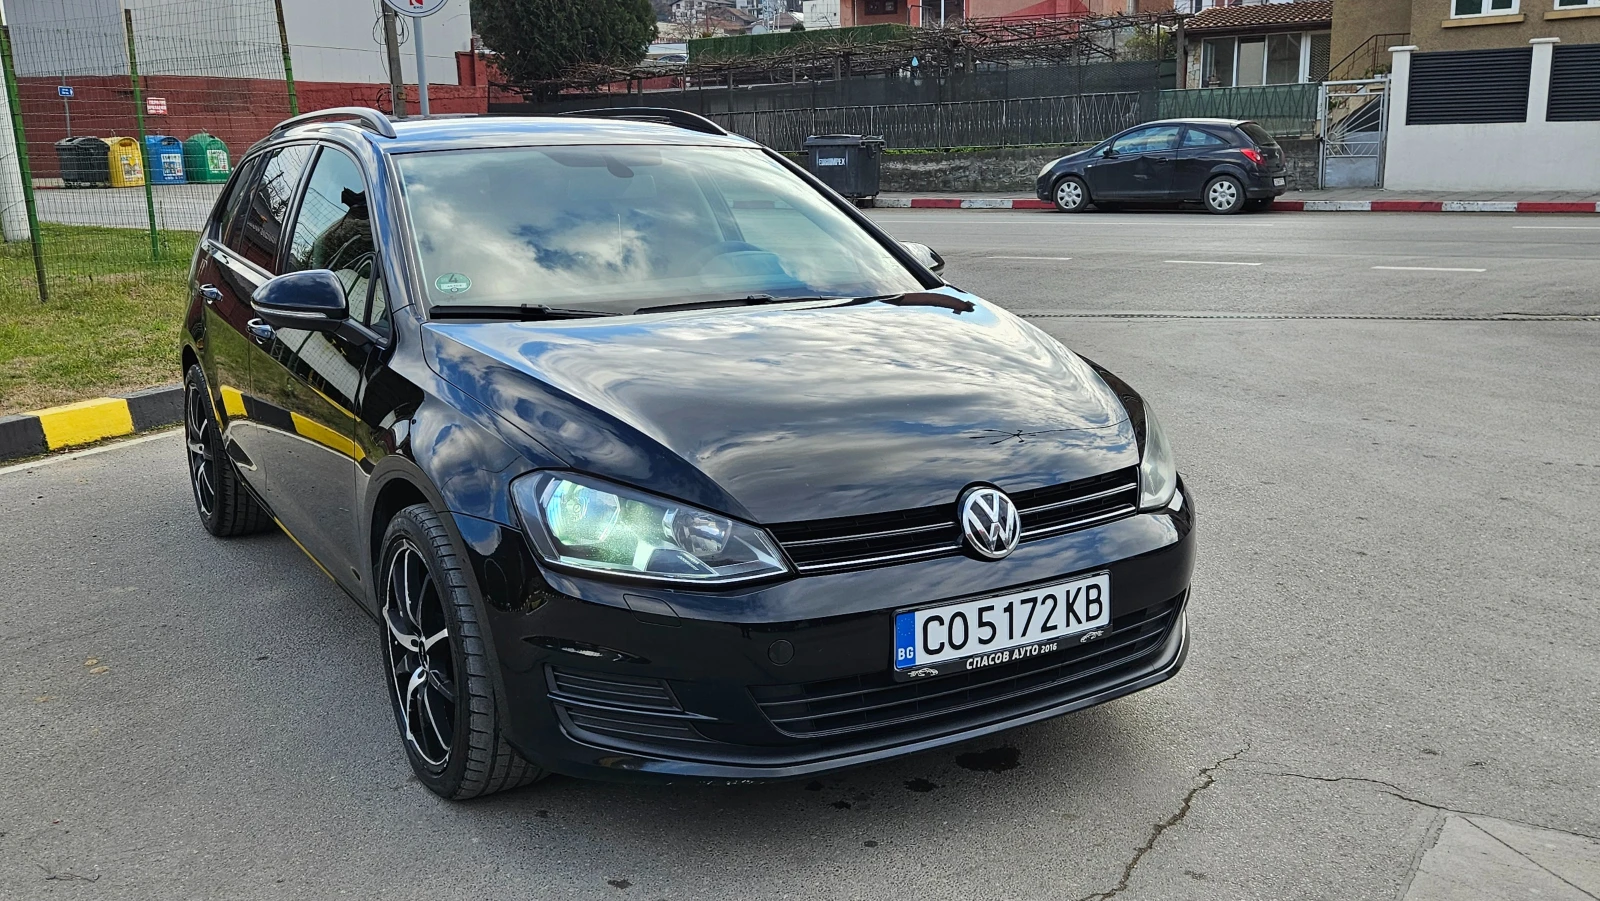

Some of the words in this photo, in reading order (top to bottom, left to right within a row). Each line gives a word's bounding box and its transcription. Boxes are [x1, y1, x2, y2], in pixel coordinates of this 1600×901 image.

[897, 646, 915, 661] BG
[966, 651, 1010, 670] СПАСОВ
[1012, 644, 1039, 661] АУТО
[1040, 642, 1058, 654] 2016
